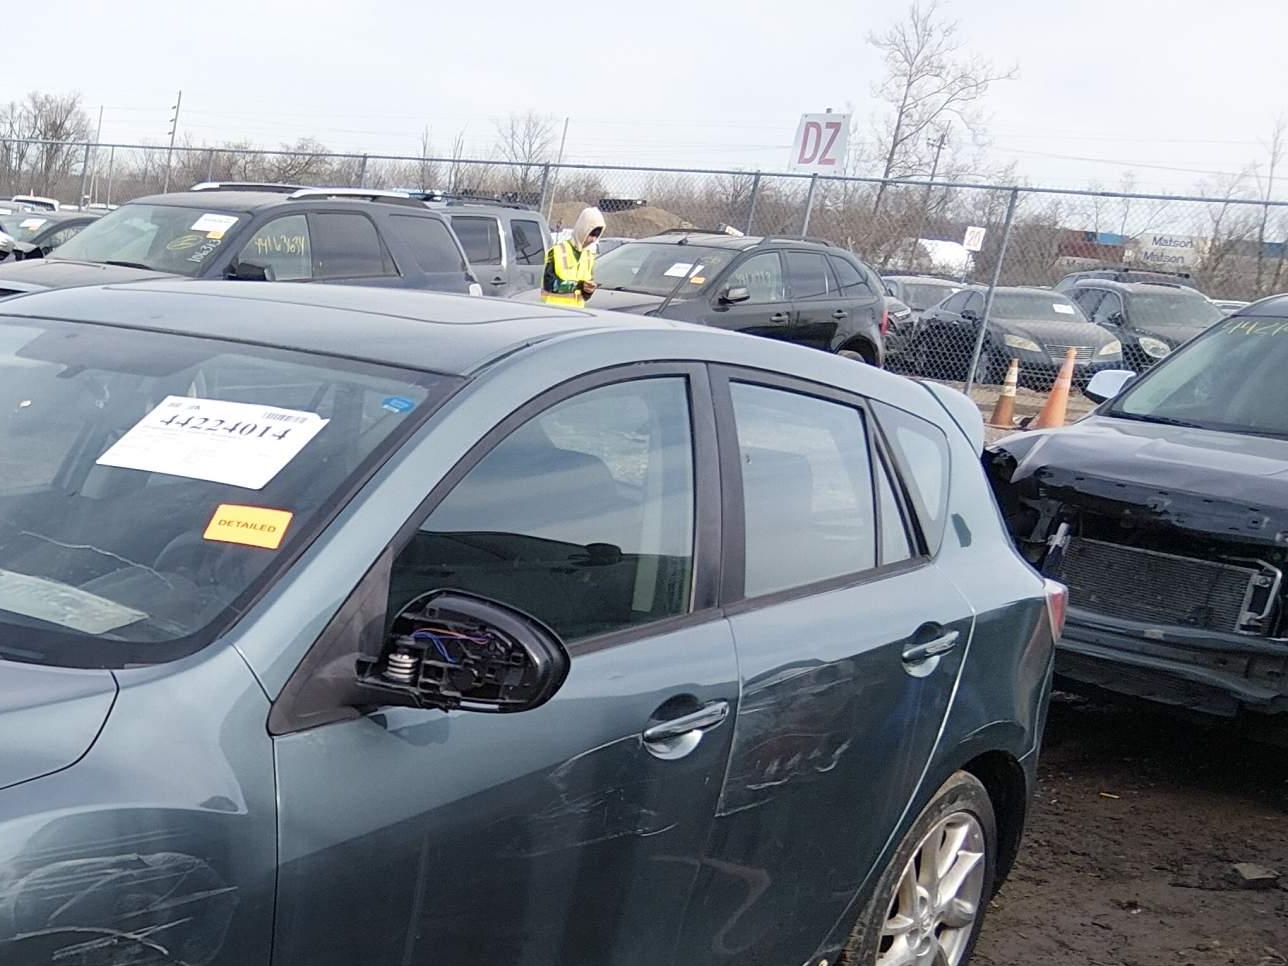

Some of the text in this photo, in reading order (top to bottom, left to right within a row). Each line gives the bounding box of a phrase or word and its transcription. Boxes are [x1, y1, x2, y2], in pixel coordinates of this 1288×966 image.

[797, 121, 842, 166] DZ
[1151, 235, 1193, 250] Matson
[1142, 250, 1185, 264] Matson
[159, 414, 292, 441] 44224014
[217, 519, 277, 533] DETAILED
